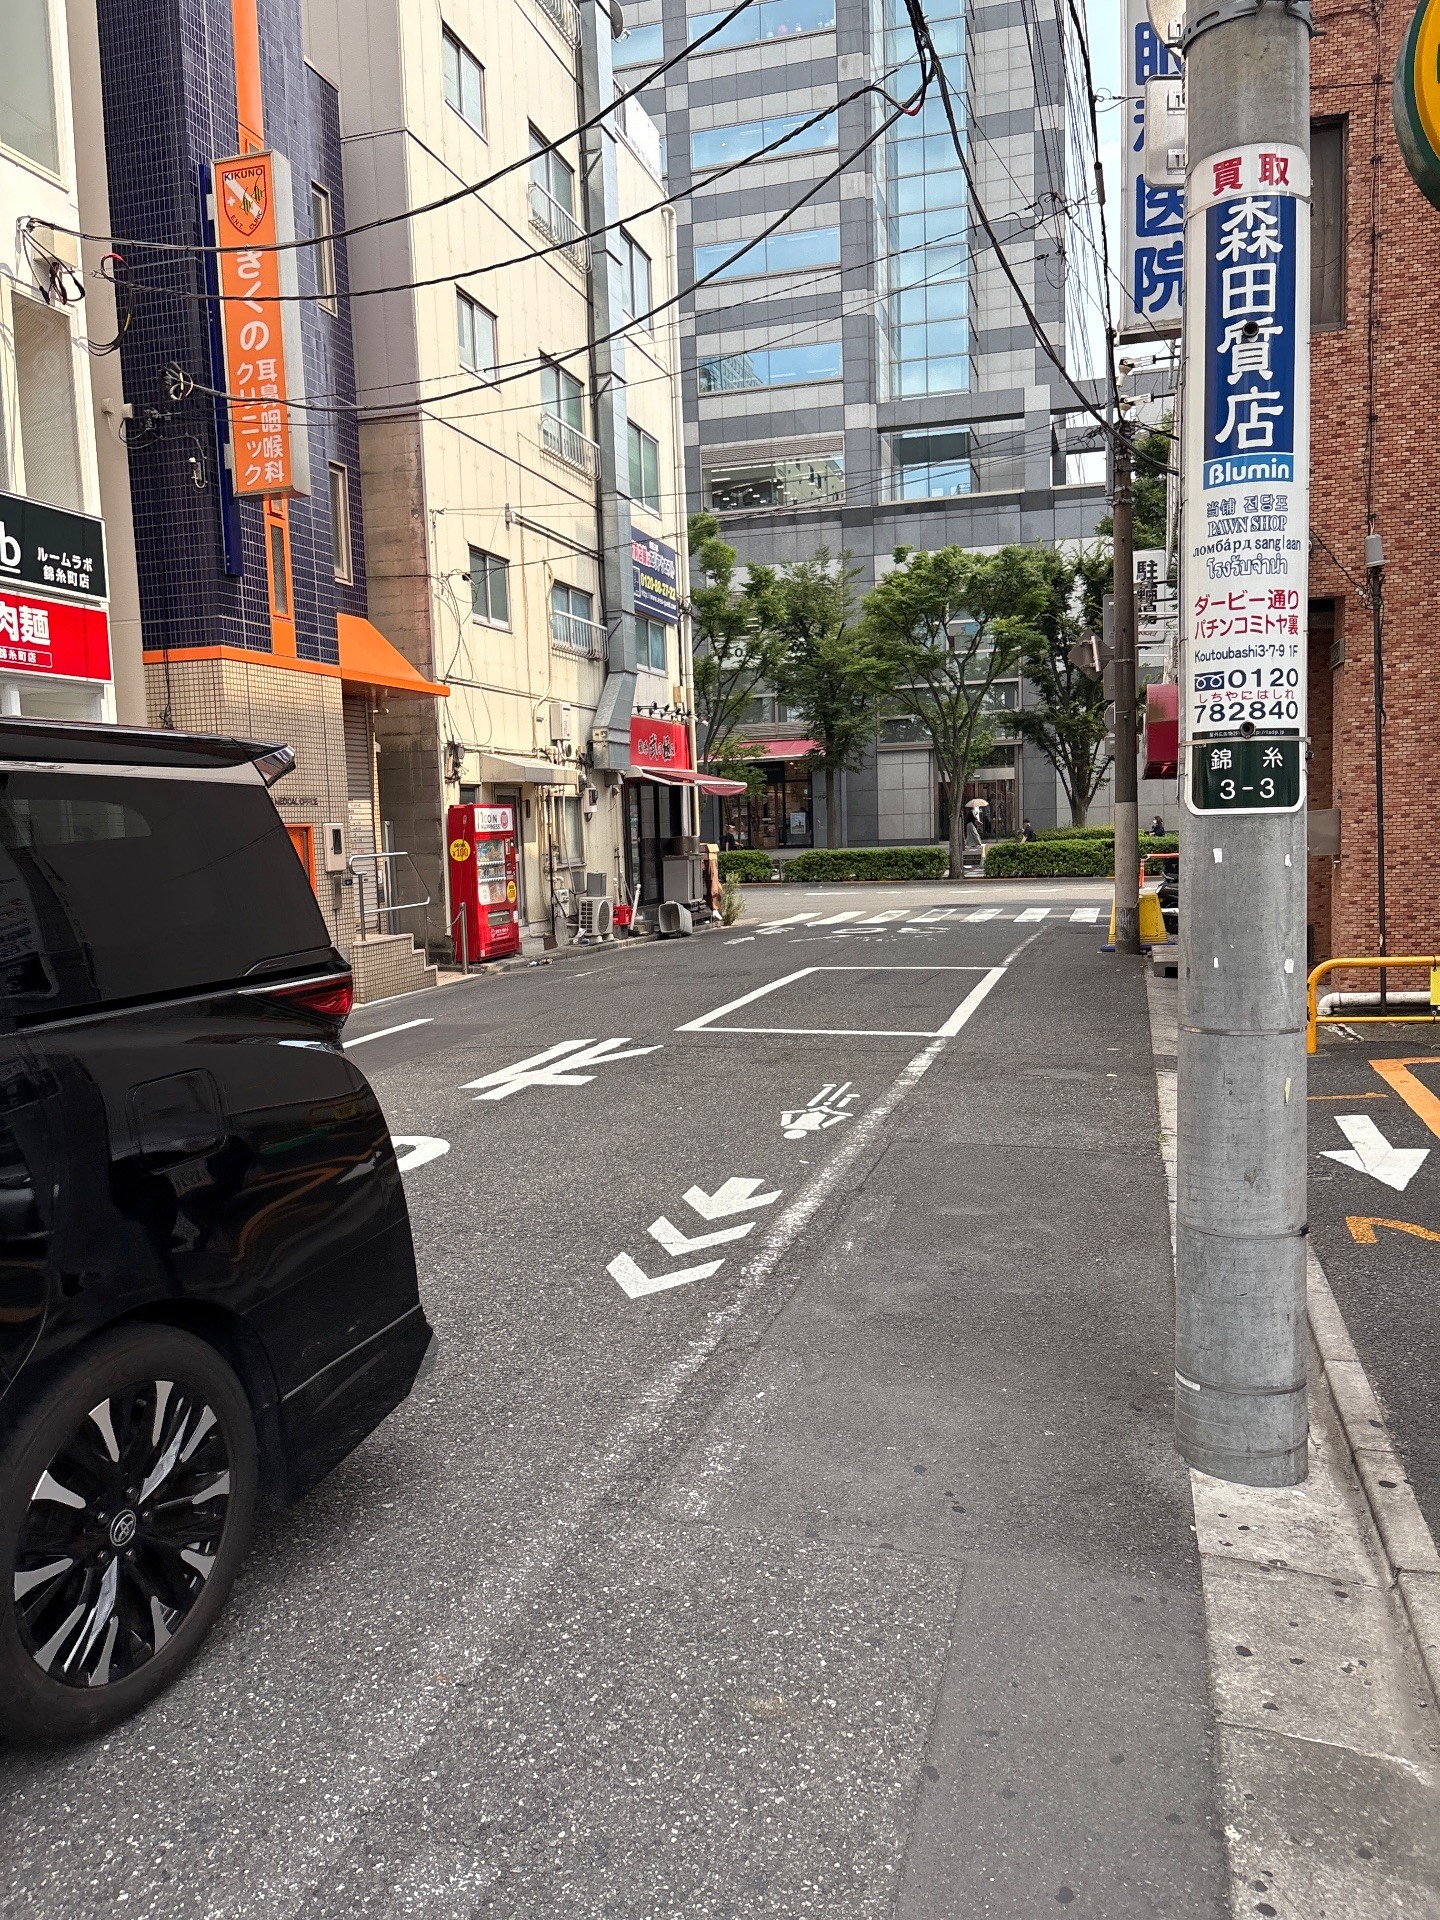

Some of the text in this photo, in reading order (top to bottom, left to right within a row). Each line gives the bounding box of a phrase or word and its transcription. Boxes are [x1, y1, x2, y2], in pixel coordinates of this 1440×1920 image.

[224, 168, 263, 181] KIKUNO
[1212, 153, 1290, 196] 買取
[249, 210, 263, 230] CLINIC
[236, 244, 270, 352] きくの
[1214, 197, 1284, 449] 森田質店
[236, 362, 263, 486] クリニック
[255, 357, 285, 484] 耳鼻咽喉科
[1244, 494, 1289, 513] 전당포
[1208, 515, 1288, 537] PAWN SHOP
[37, 546, 93, 573] ルームラボ
[43, 565, 90, 589] 錦糸町店
[1194, 589, 1299, 617] ダービー通り
[1194, 613, 1299, 640] パチンコミトヤ裏
[1228, 667, 1299, 688] 0120
[1199, 689, 1295, 704] しちやにはしれ
[1194, 700, 1299, 724] 782840
[1210, 746, 1283, 770] 錦糸
[1219, 777, 1275, 800] 3-3
